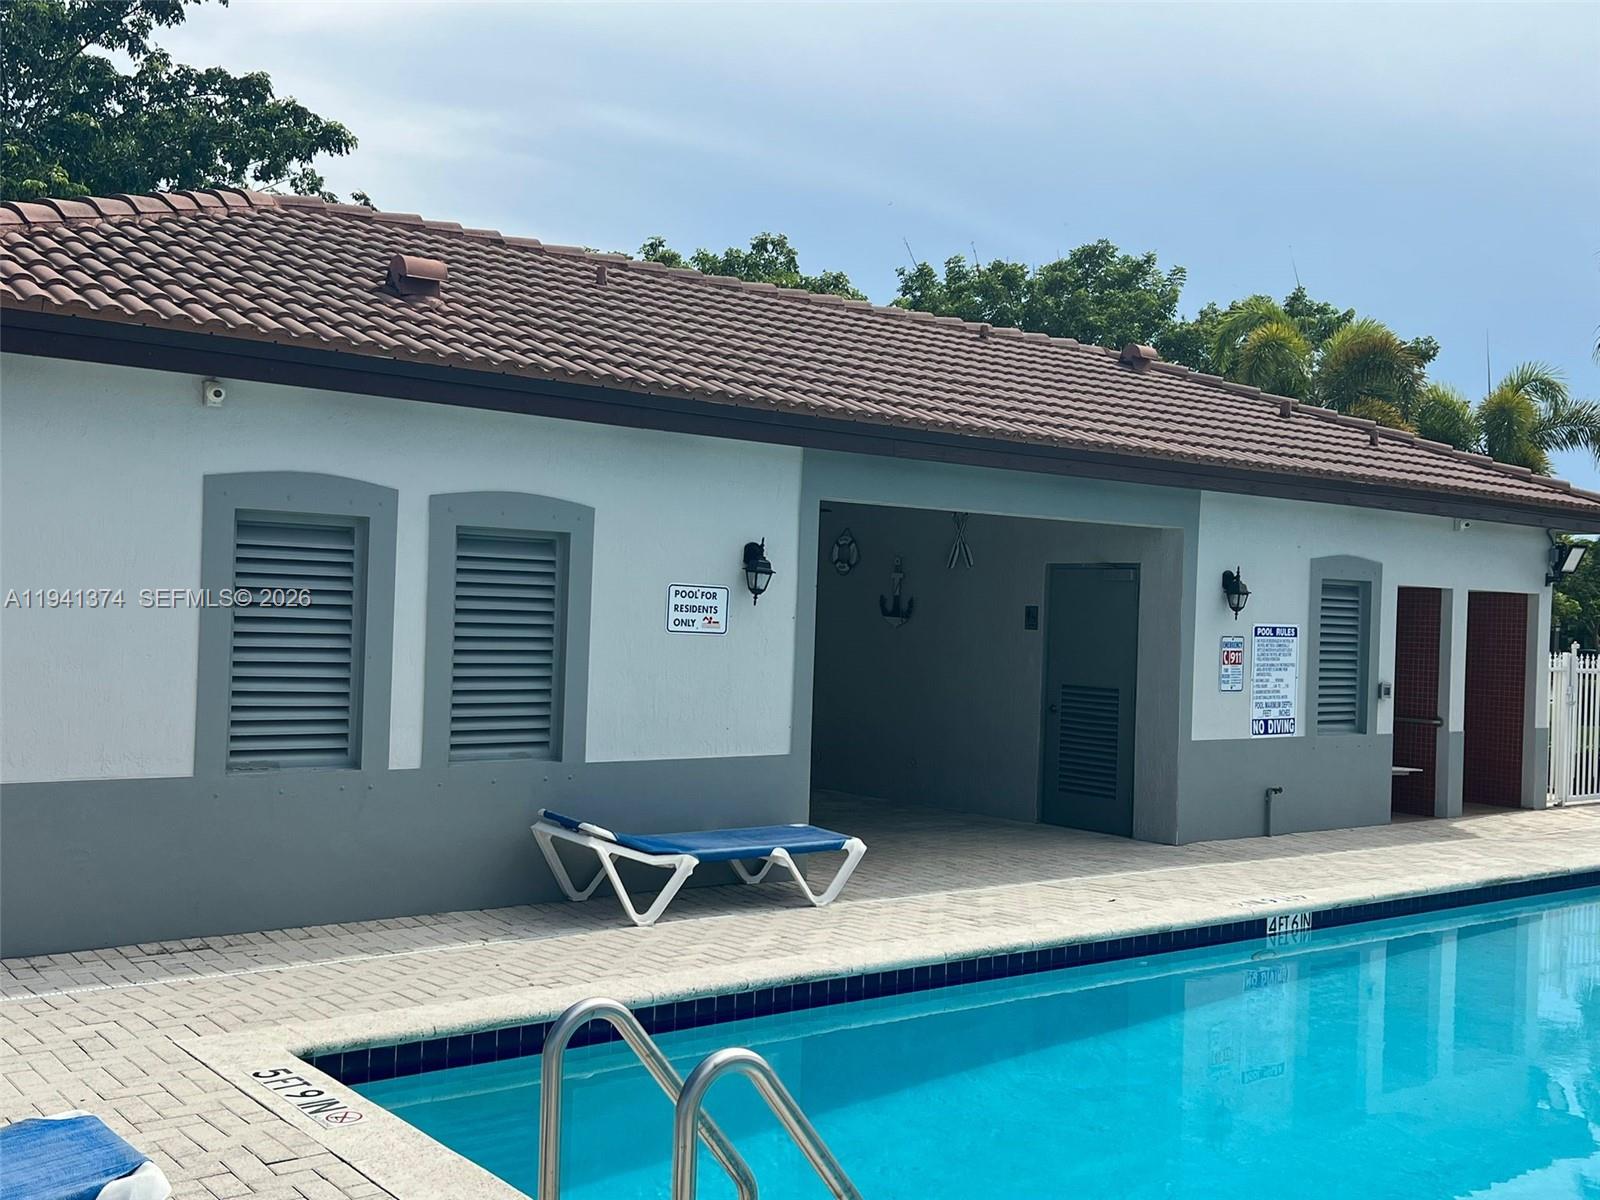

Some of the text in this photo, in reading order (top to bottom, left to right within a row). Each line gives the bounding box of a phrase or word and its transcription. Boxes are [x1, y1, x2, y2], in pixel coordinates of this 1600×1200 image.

[674, 590, 718, 600] POOL FOR
[673, 604, 718, 614] RESIDENTS
[673, 618, 696, 627] ONLY
[1256, 627, 1296, 636] POOL RULES
[1230, 651, 1242, 663] 911
[1252, 718, 1295, 734] NO DIVING
